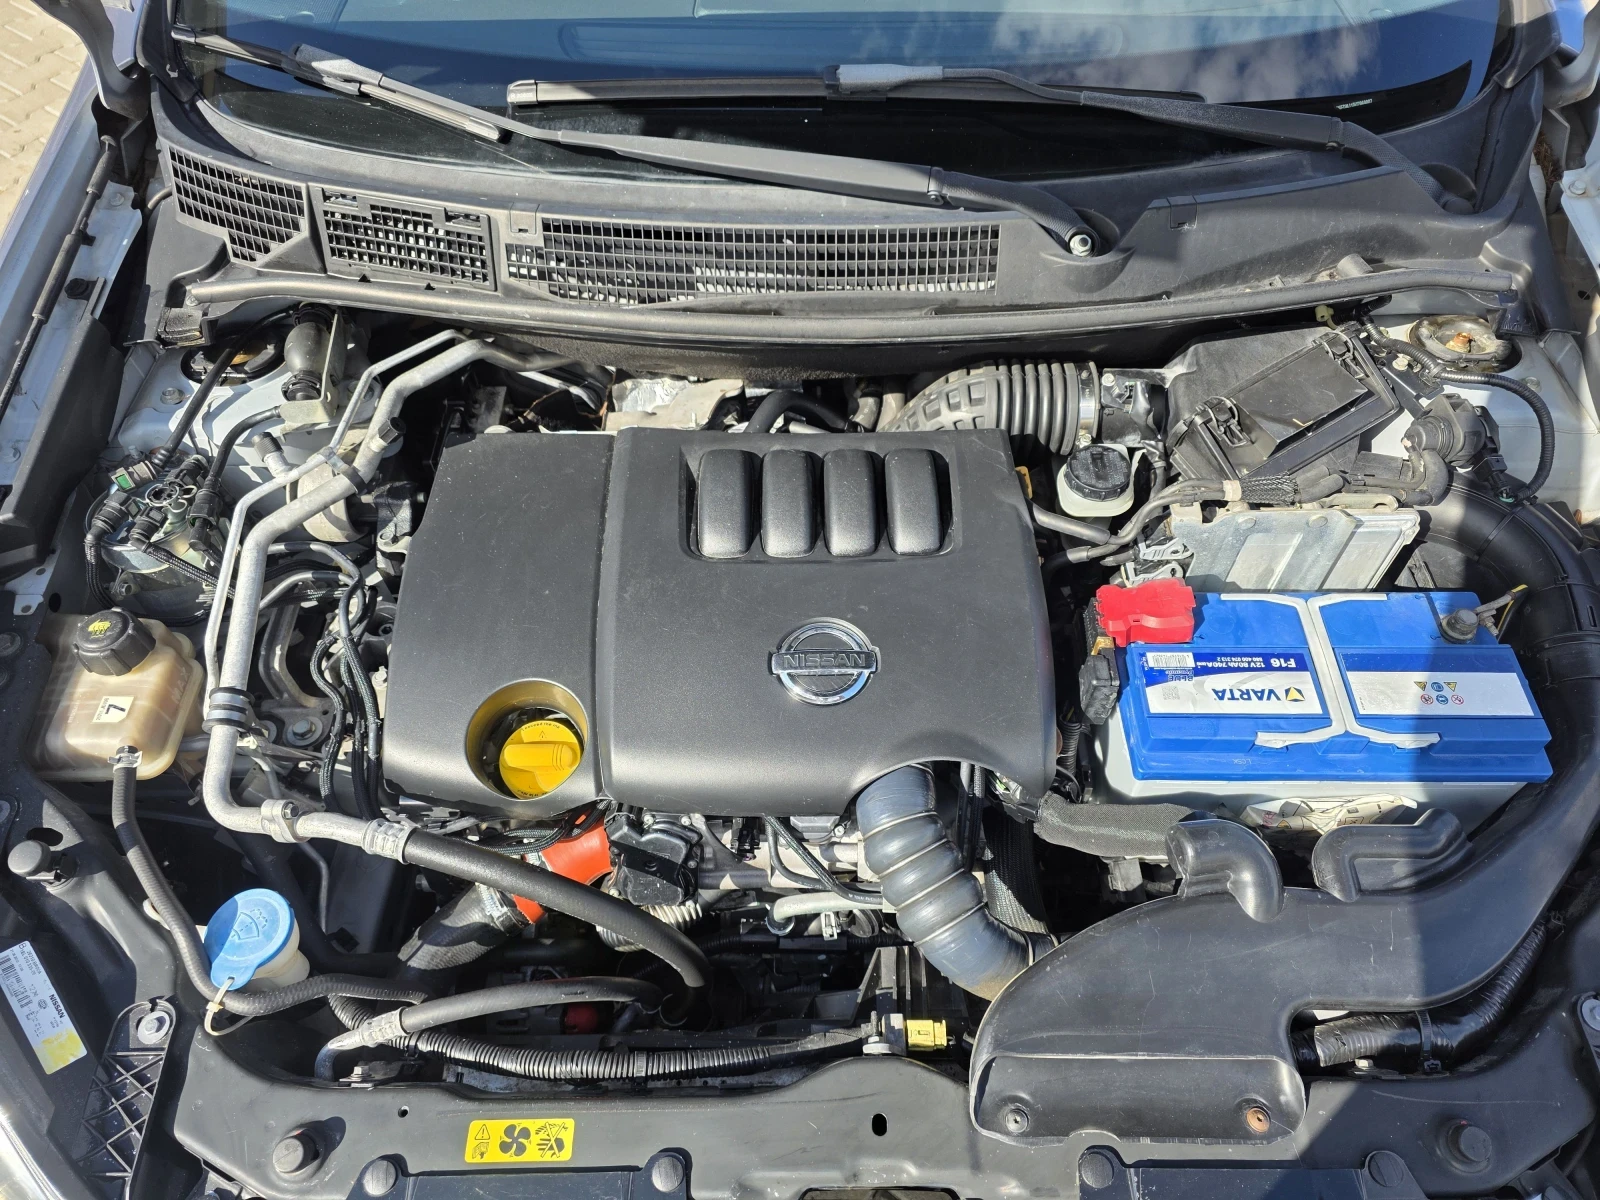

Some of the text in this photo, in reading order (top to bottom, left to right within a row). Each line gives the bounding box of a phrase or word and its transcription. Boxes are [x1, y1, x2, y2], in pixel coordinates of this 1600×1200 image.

[783, 653, 866, 668] NISSAN
[1270, 658, 1296, 668] F16
[1212, 688, 1282, 701] VARTA
[49, 994, 65, 1018] NISSAN
